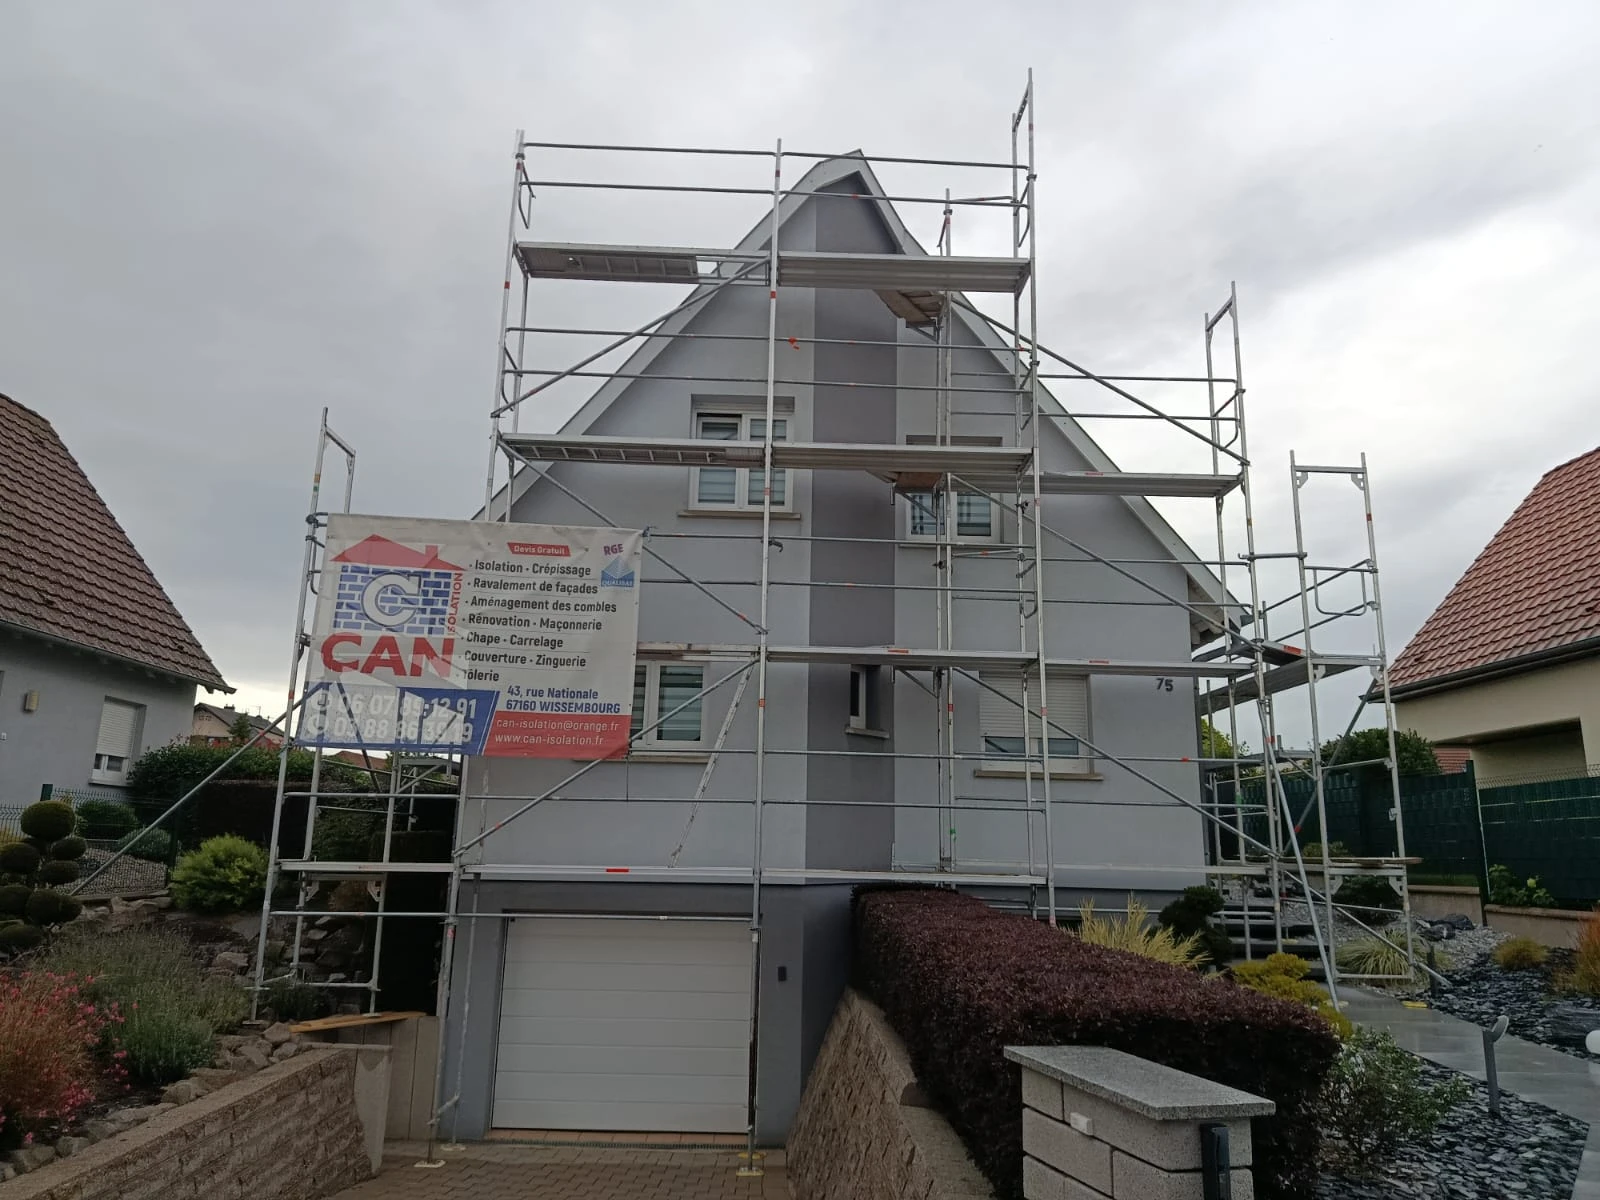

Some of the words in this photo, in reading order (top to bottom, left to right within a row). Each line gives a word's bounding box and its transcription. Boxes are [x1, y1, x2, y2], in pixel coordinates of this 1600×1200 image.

[513, 545, 537, 554] Devis
[538, 547, 566, 556] Gratuit
[603, 543, 625, 556] RGE
[474, 559, 524, 573] Isolation
[531, 562, 592, 578] Crépissage
[473, 577, 537, 592] Ravalement
[539, 579, 553, 592] de
[555, 581, 599, 596] façades
[470, 595, 549, 612] Aménagement
[552, 599, 572, 612] des
[574, 601, 617, 613] combles
[468, 613, 530, 627] Rénovation
[539, 618, 603, 632] Maçonnerie
[466, 631, 501, 646] Chape
[509, 634, 564, 650] Carrelage
[321, 632, 455, 678] CAN
[464, 650, 527, 665] Couverture
[535, 655, 587, 669] Zinguerie
[507, 685, 524, 698] 43,
[526, 689, 544, 698] rue
[547, 687, 599, 700] Nationale
[1156, 677, 1174, 692] 75
[369, 694, 396, 715] 07
[456, 698, 477, 719] 91
[505, 700, 537, 712] 67160
[539, 701, 621, 714] WISSEMBOURG
[364, 718, 389, 739] 88
[496, 719, 620, 733] can-isolation@orange.fr
[494, 734, 604, 746] www.can-isolation.fr
